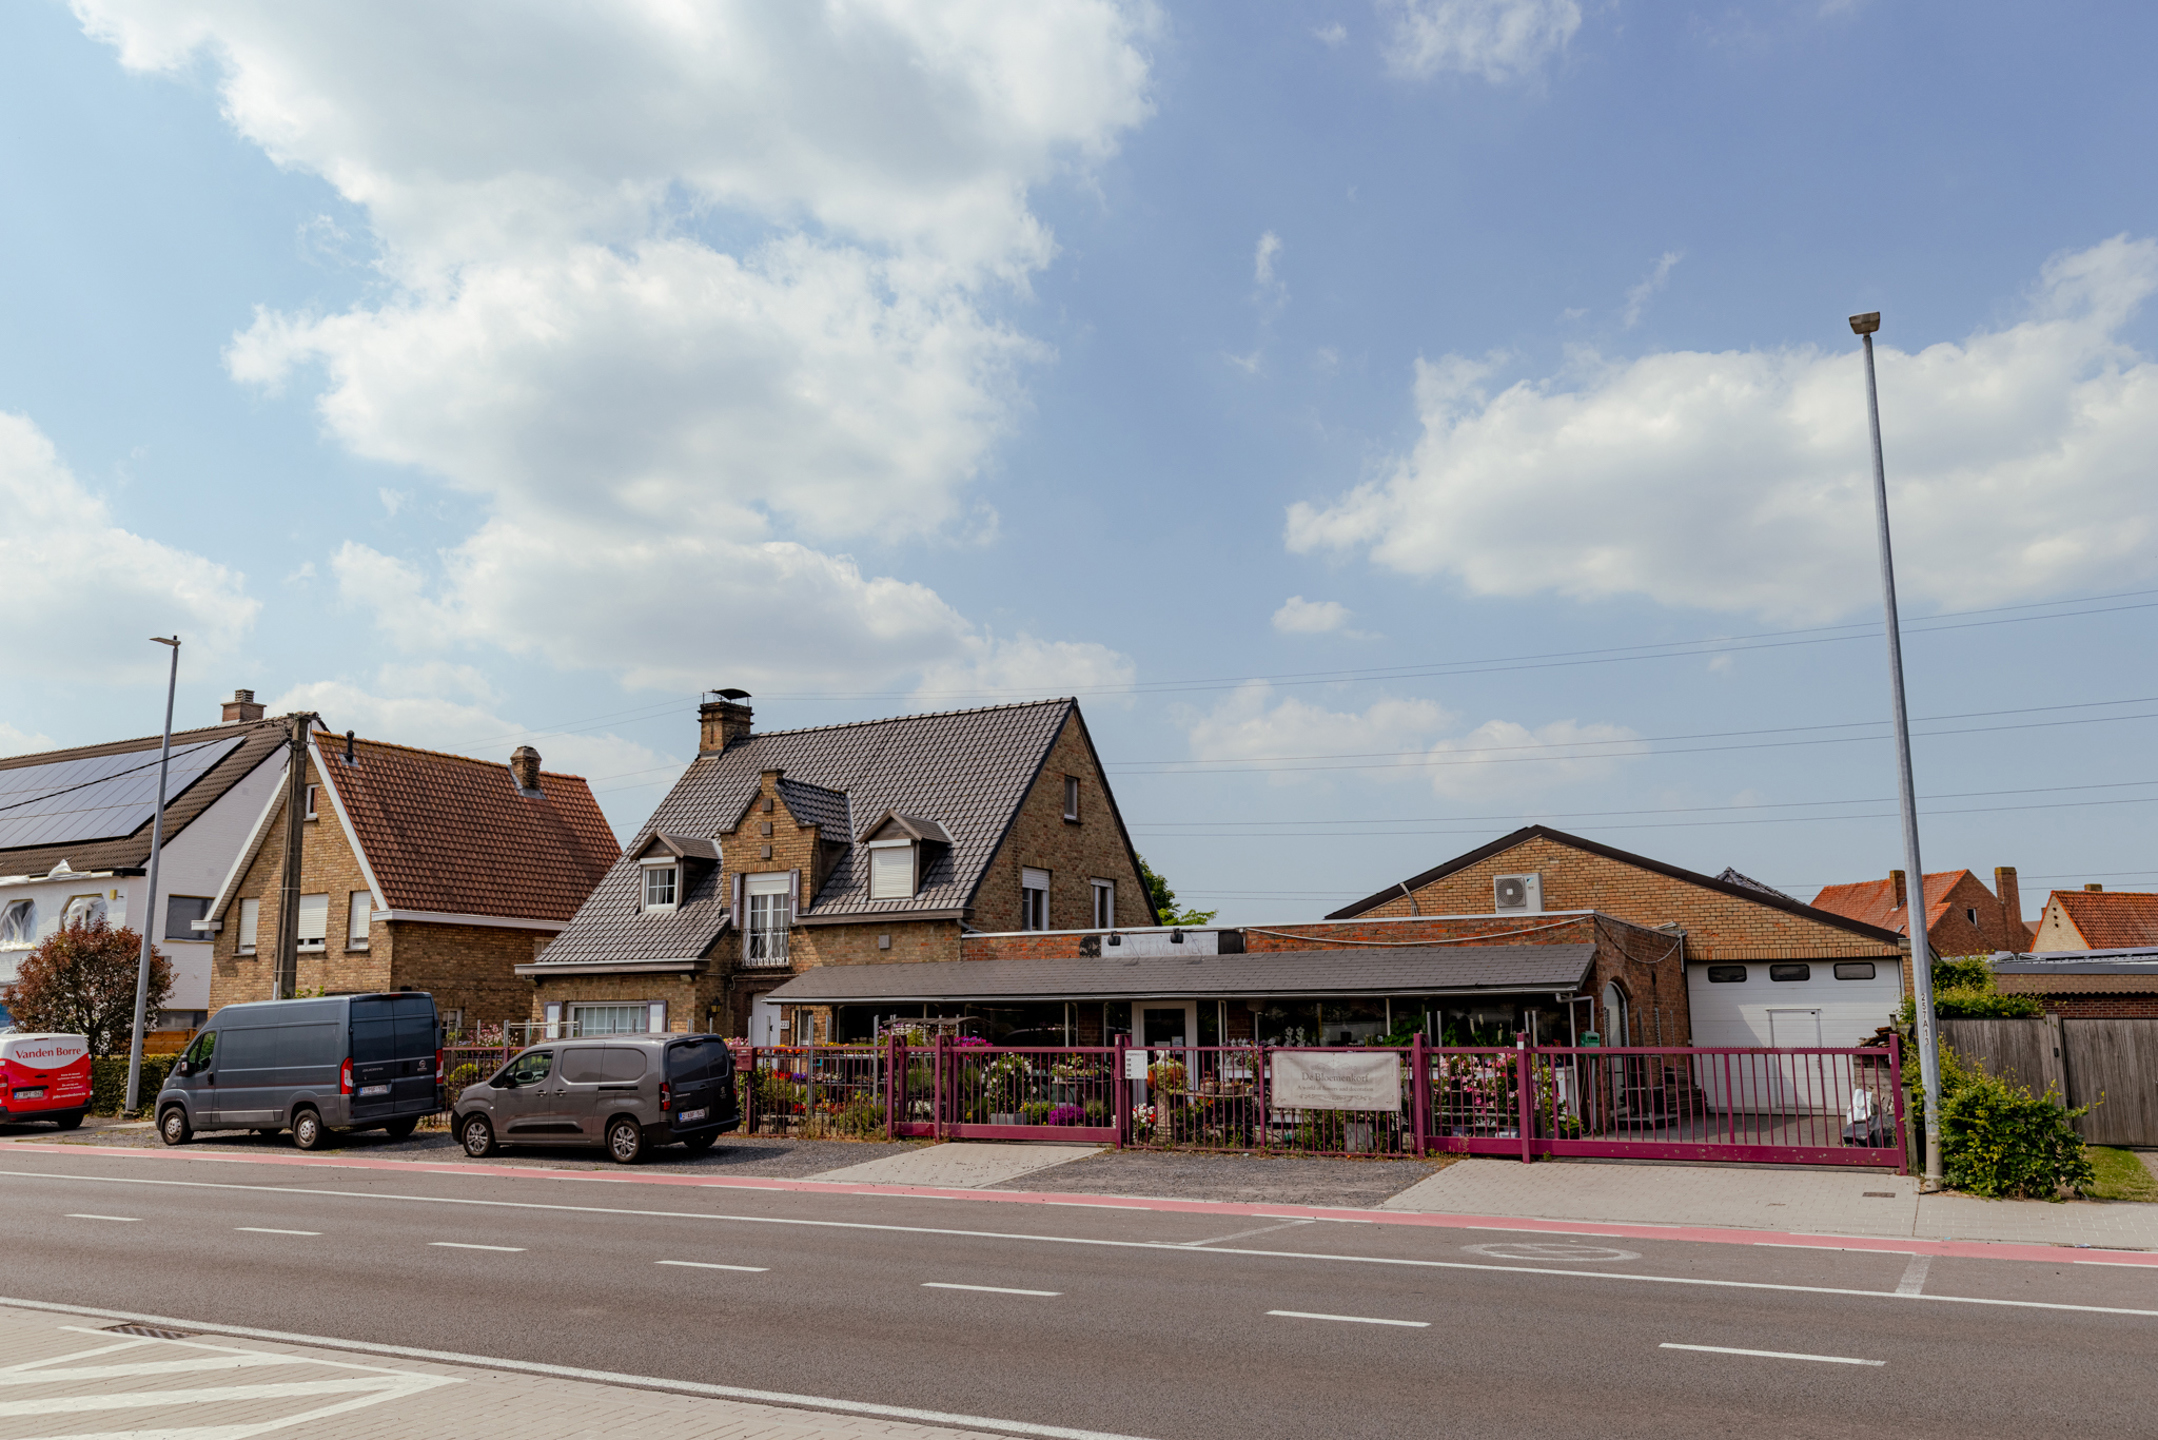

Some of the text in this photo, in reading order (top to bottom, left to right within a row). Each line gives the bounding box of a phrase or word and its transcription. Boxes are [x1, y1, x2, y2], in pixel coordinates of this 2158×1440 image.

[1921, 993, 1930, 1046] 257A13
[15, 1047, 82, 1060] Vanden Borre
[1301, 1072, 1370, 1083] De Bloemenkorf
